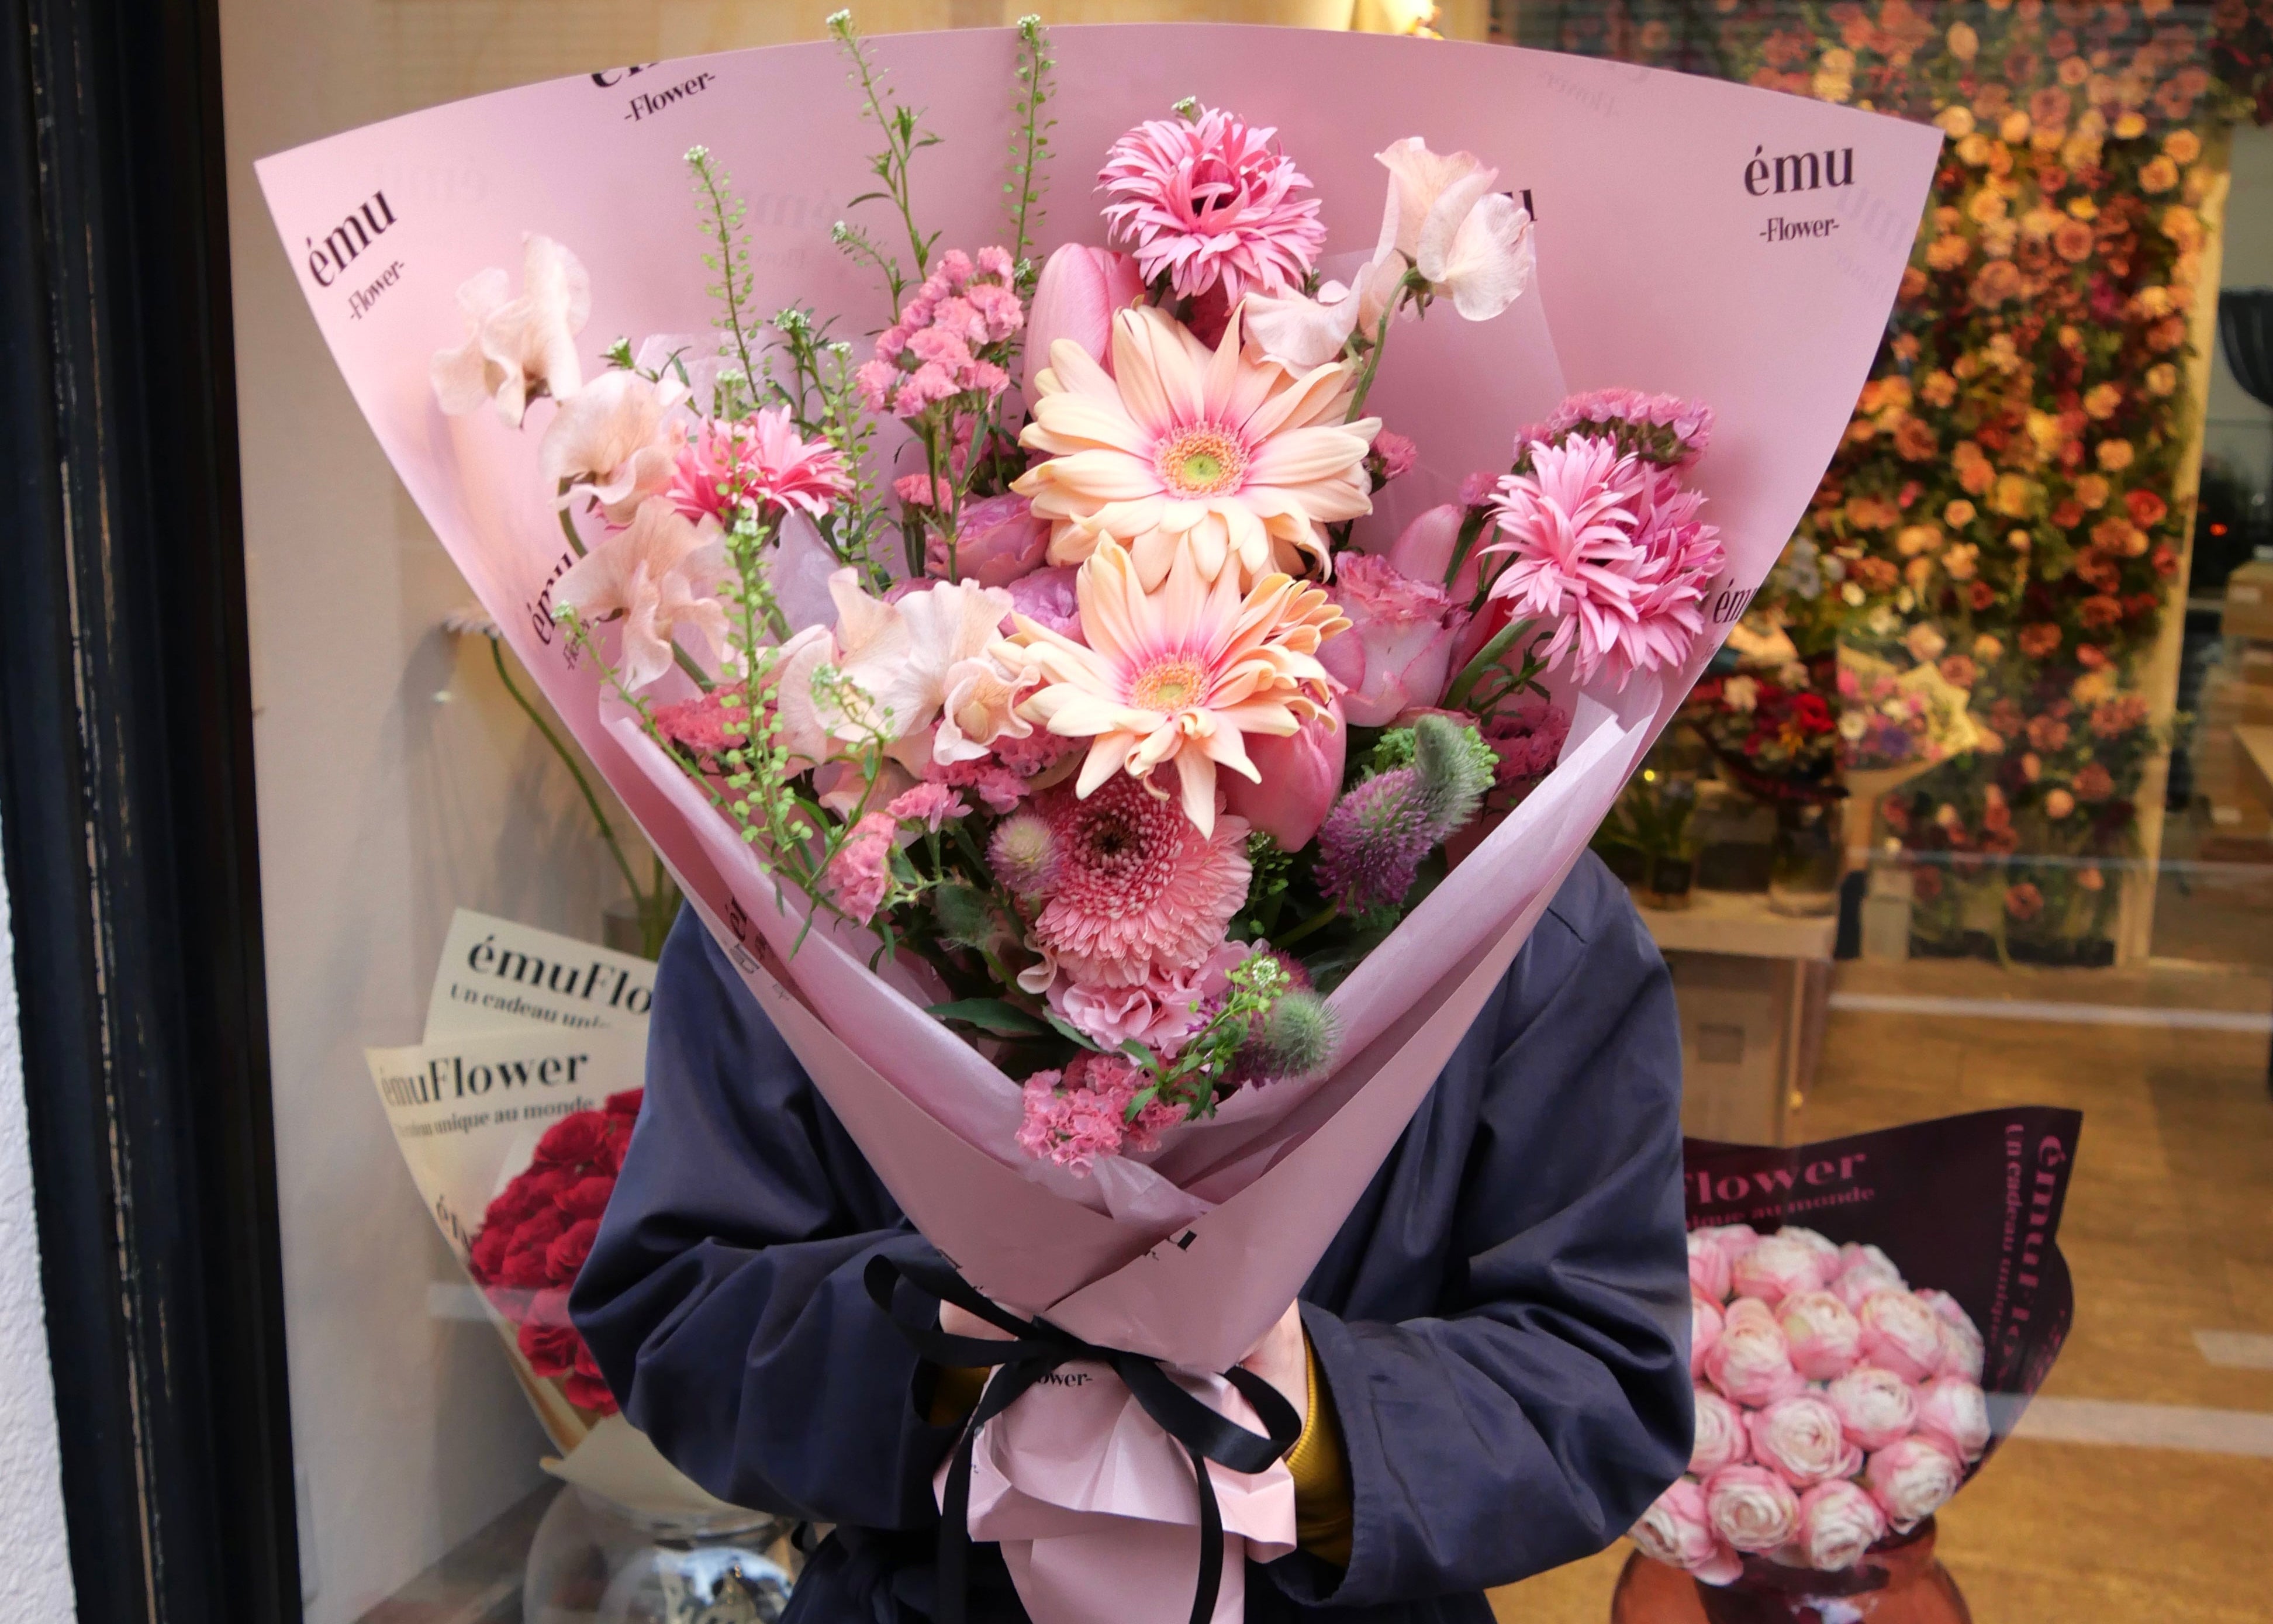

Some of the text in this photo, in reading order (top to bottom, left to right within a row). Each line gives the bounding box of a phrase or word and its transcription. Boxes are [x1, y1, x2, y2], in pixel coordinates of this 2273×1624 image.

[624, 72, 716, 122] -Flower-
[1744, 144, 1855, 196] ému
[306, 189, 398, 288] ému
[1759, 216, 1840, 243] -Flower-
[348, 260, 405, 320] -Flower-
[1712, 578, 1758, 624] ém
[380, 1053, 588, 1105] émuFlower
